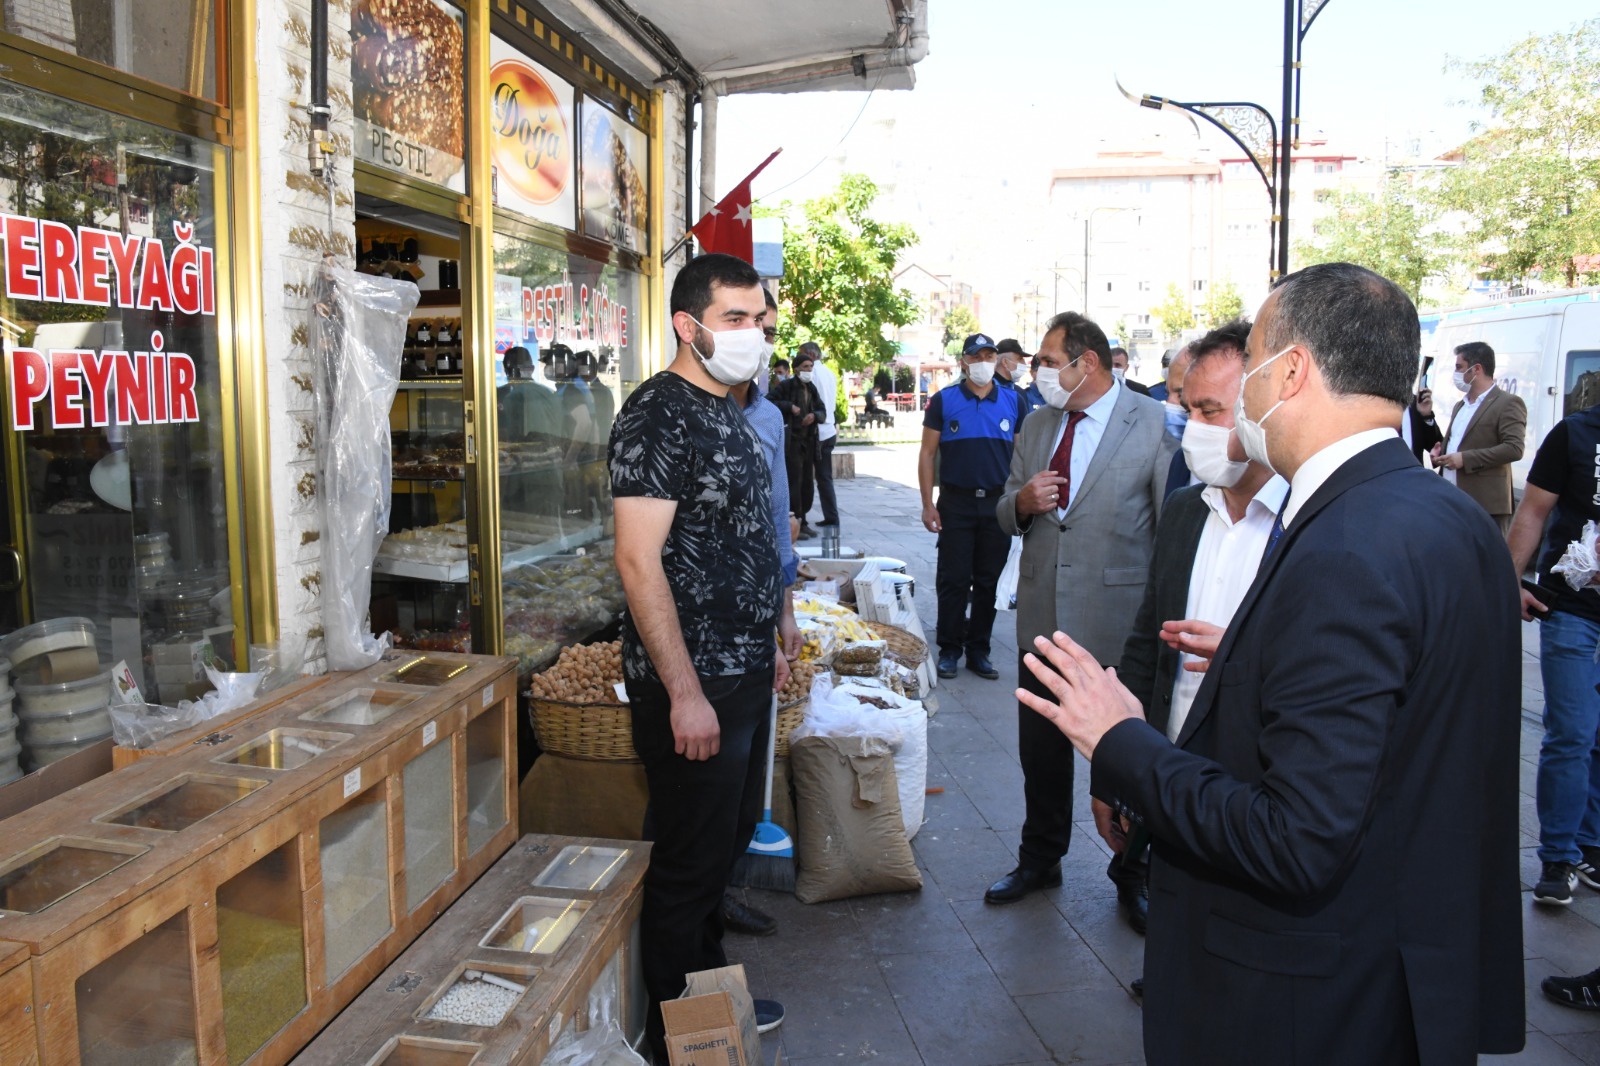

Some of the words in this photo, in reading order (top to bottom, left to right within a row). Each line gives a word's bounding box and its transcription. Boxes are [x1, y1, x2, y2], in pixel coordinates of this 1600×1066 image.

[493, 82, 561, 170] Doğa
[0, 214, 216, 315] EREYAĞI
[522, 268, 577, 343] PESTİL
[580, 283, 590, 340] &
[592, 282, 628, 347] KÖME
[11, 330, 200, 431] PEYNİR
